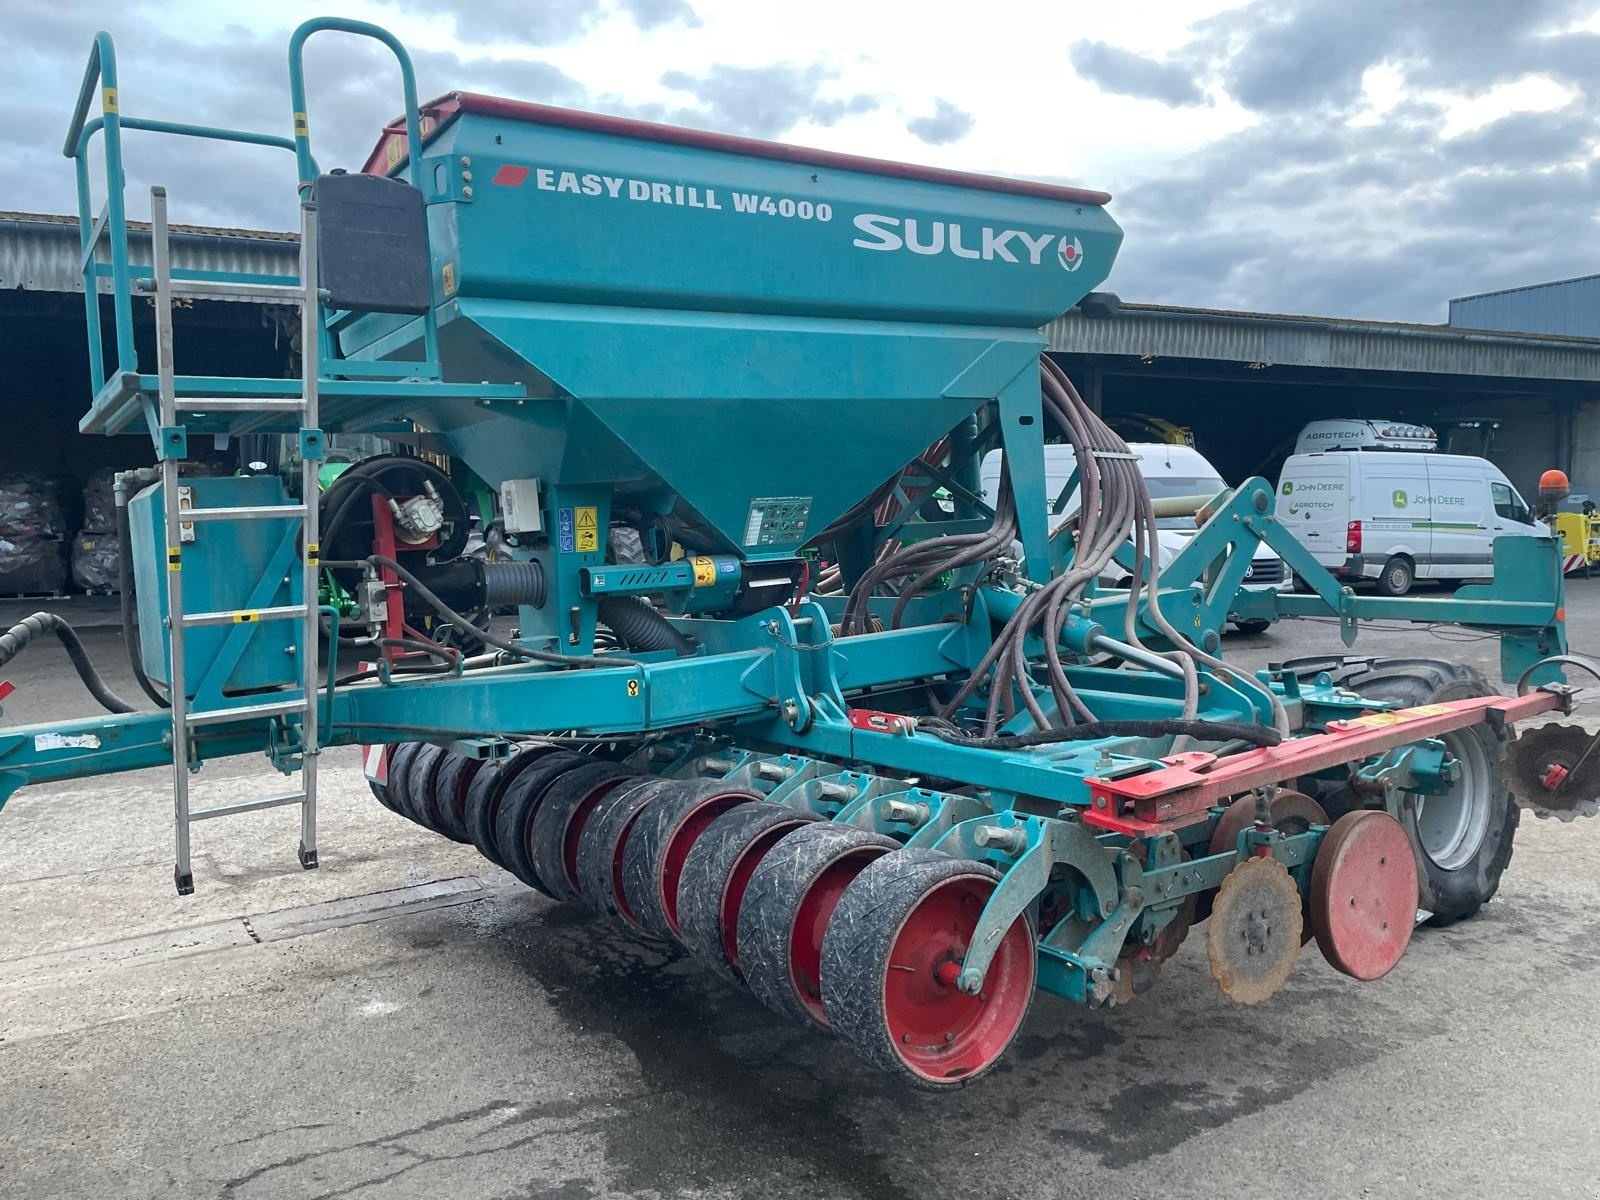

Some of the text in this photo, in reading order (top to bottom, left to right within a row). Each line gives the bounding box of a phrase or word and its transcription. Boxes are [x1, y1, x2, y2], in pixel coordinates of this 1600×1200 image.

[732, 192, 833, 222] W4000
[853, 213, 1055, 265] SULKY
[1305, 431, 1359, 440] AGROTECH
[1296, 482, 1345, 492] JOHN DEERE
[1412, 494, 1465, 506] JOHN DEERE
